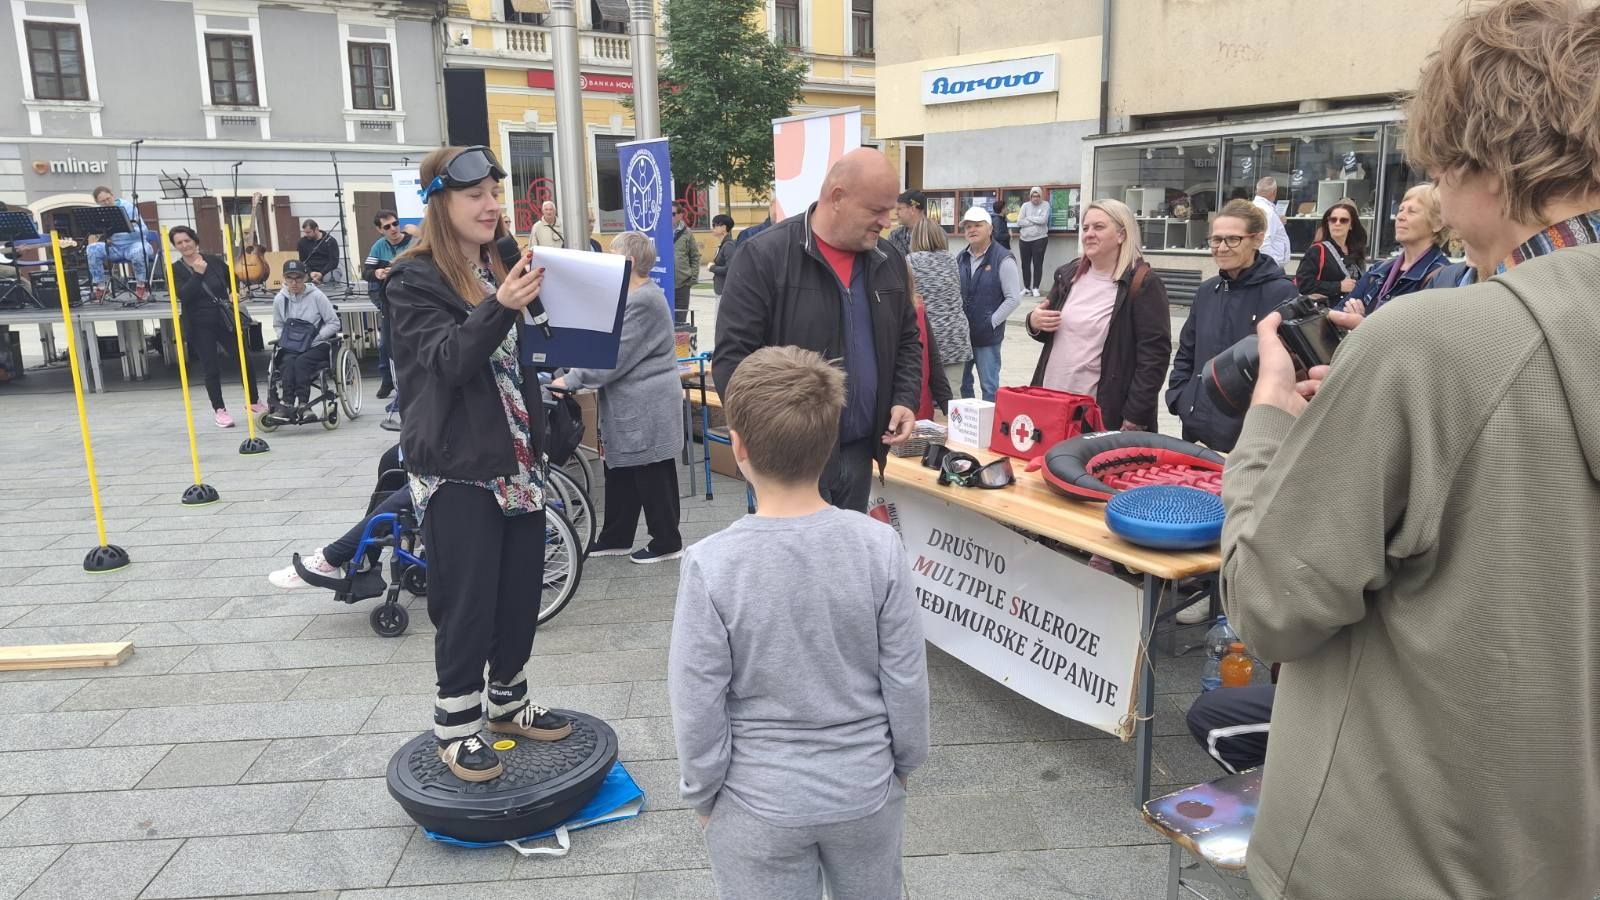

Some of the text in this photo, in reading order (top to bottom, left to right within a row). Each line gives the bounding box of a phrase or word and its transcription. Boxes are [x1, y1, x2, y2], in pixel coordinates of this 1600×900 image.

[50, 157, 108, 173] mlinar
[927, 528, 1006, 574] DRUŠTVO
[912, 555, 1101, 658] MULTIPLE SKLEROZE
[1029, 637, 1119, 708] ŽUPANIJE
